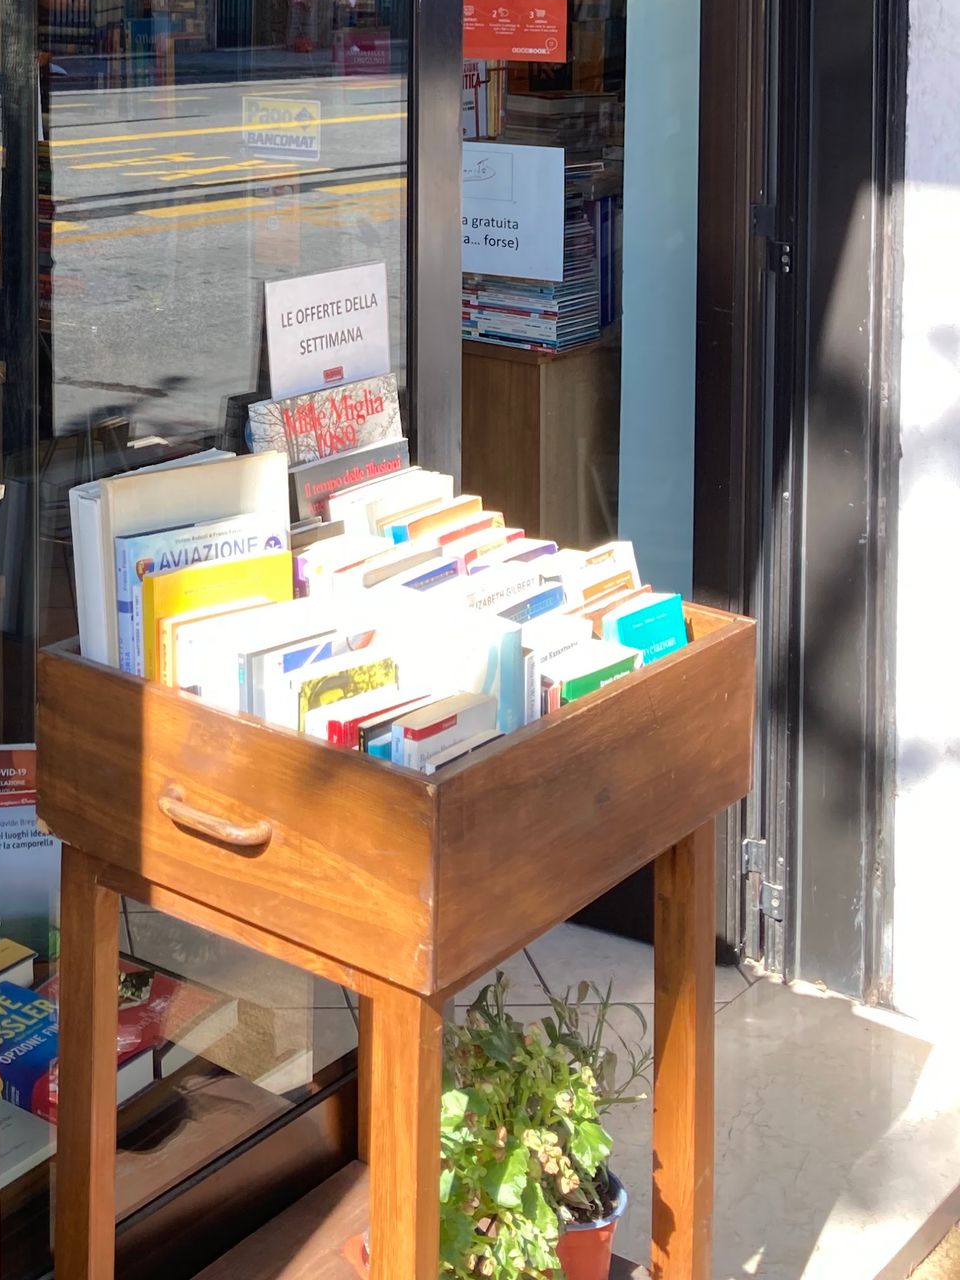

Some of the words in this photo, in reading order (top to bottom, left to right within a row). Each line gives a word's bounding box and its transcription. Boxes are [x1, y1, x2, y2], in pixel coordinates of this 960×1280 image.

[247, 132, 316, 148] BANCOMAT
[471, 217, 519, 230] gratuita
[484, 234, 519, 251] forse)
[281, 311, 294, 329] LE
[296, 299, 342, 325] OFFERTE
[345, 292, 378, 315] DELLA
[299, 326, 363, 356] SETTIMANA
[329, 389, 384, 426] Miglia
[343, 467, 365, 485] delle
[366, 454, 402, 479] illusioni
[159, 536, 259, 571] AVIAZIONE
[506, 578, 536, 598] GILBERT
[2, 839, 10, 849] la
[12, 838, 54, 850] camporella
[5, 830, 29, 841] luoghi
